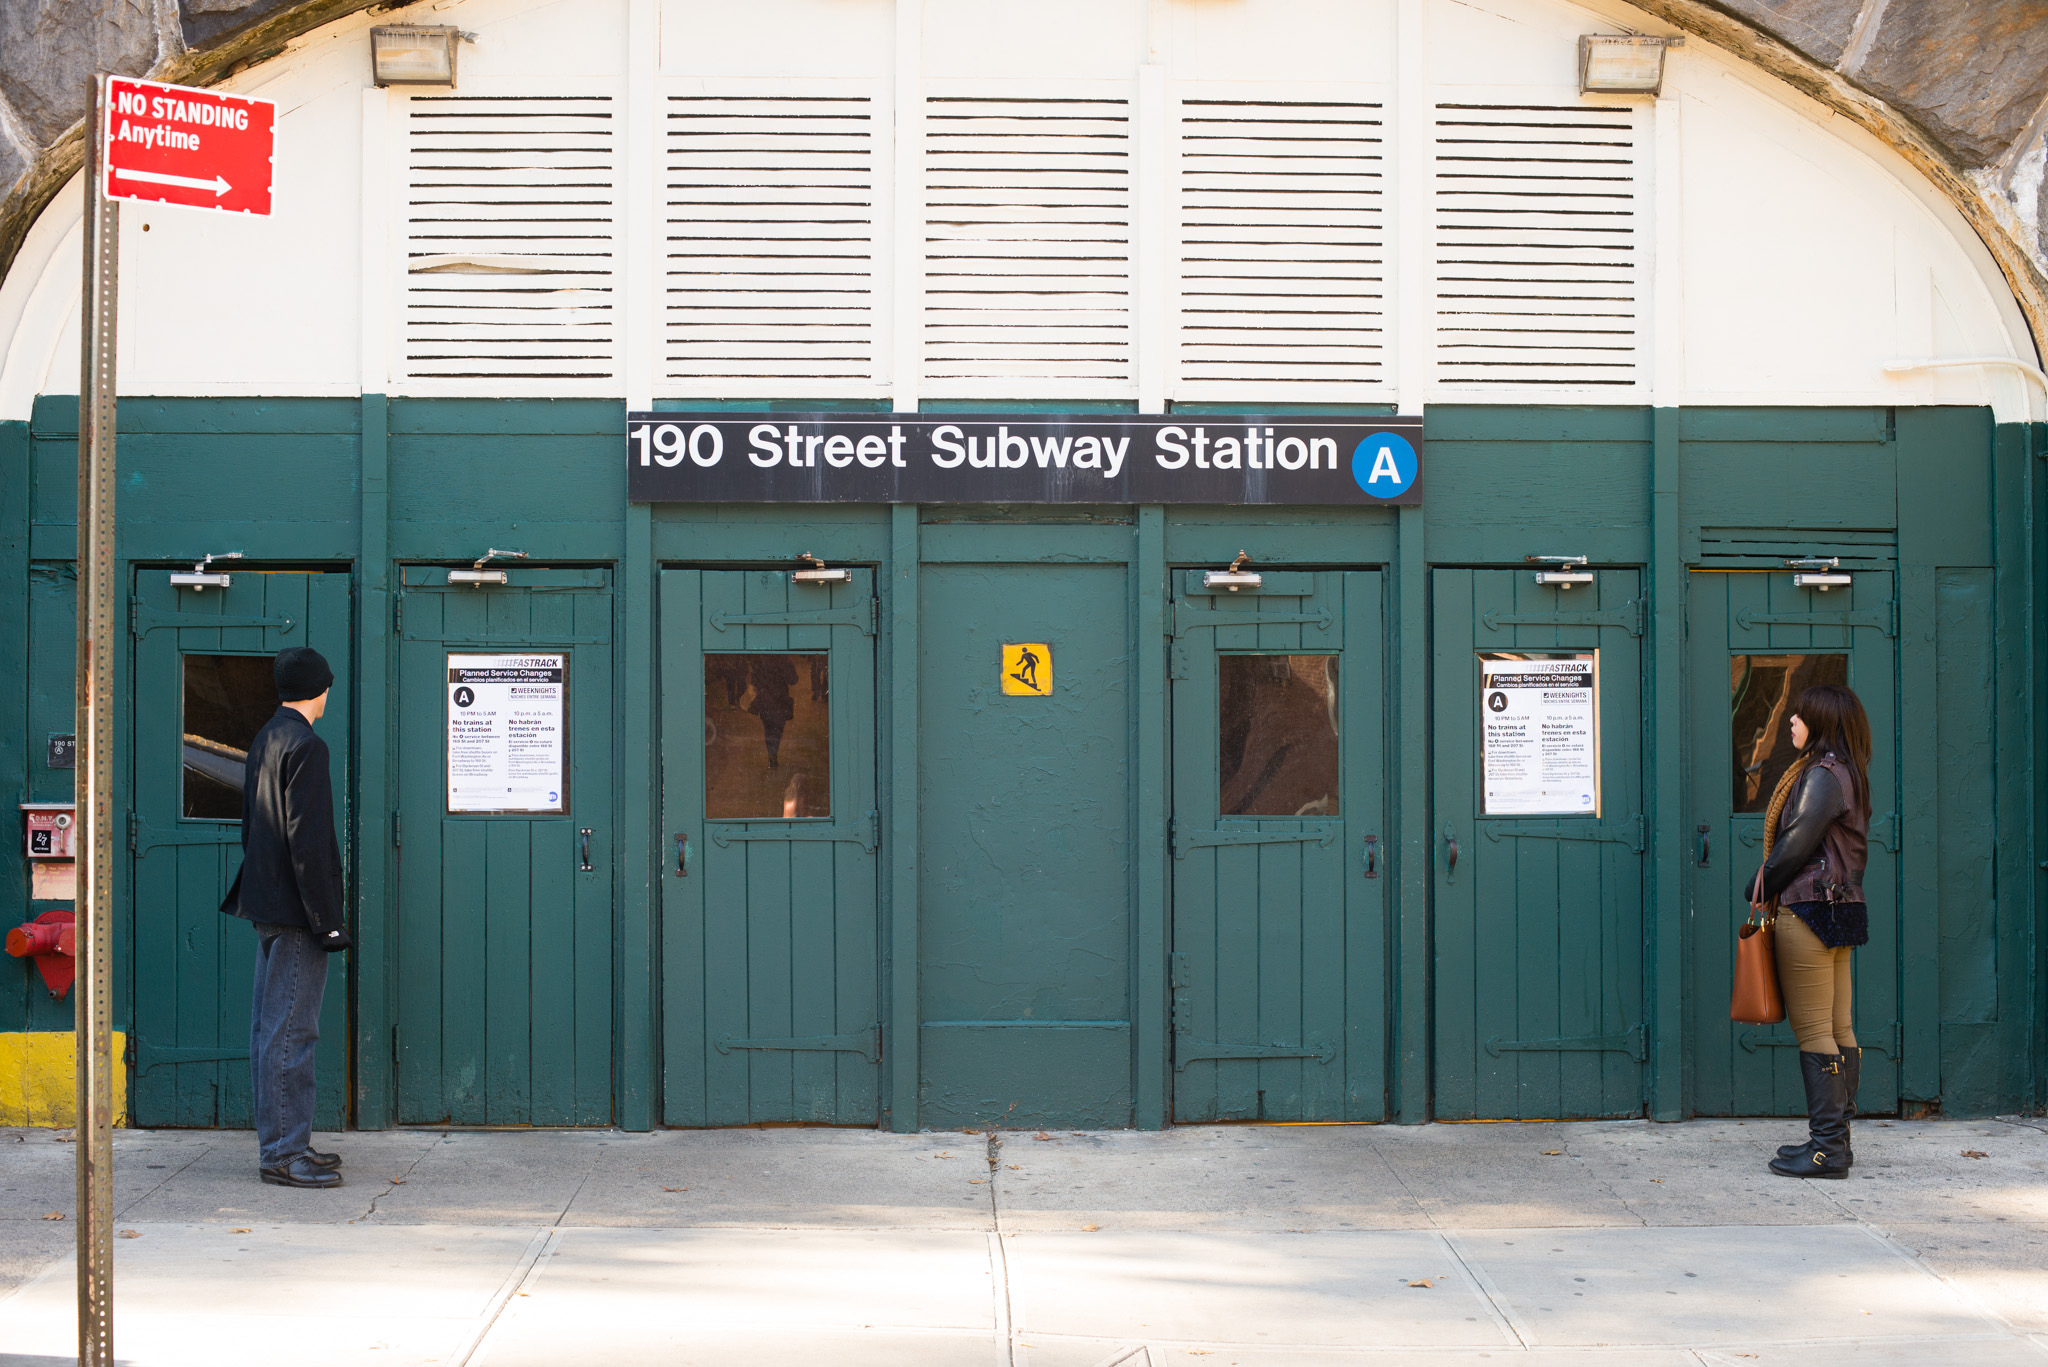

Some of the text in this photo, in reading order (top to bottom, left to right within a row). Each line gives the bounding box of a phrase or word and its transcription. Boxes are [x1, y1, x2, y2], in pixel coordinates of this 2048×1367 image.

[118, 91, 248, 130] NO STANDING
[118, 120, 200, 151] Anytime
[629, 423, 1401, 485] 190 Street Subway Station A
[513, 658, 558, 667] FASTRACK
[1544, 663, 1588, 672] FASTRACK
[519, 670, 552, 678] Changes
[1551, 675, 1582, 683] Changes
